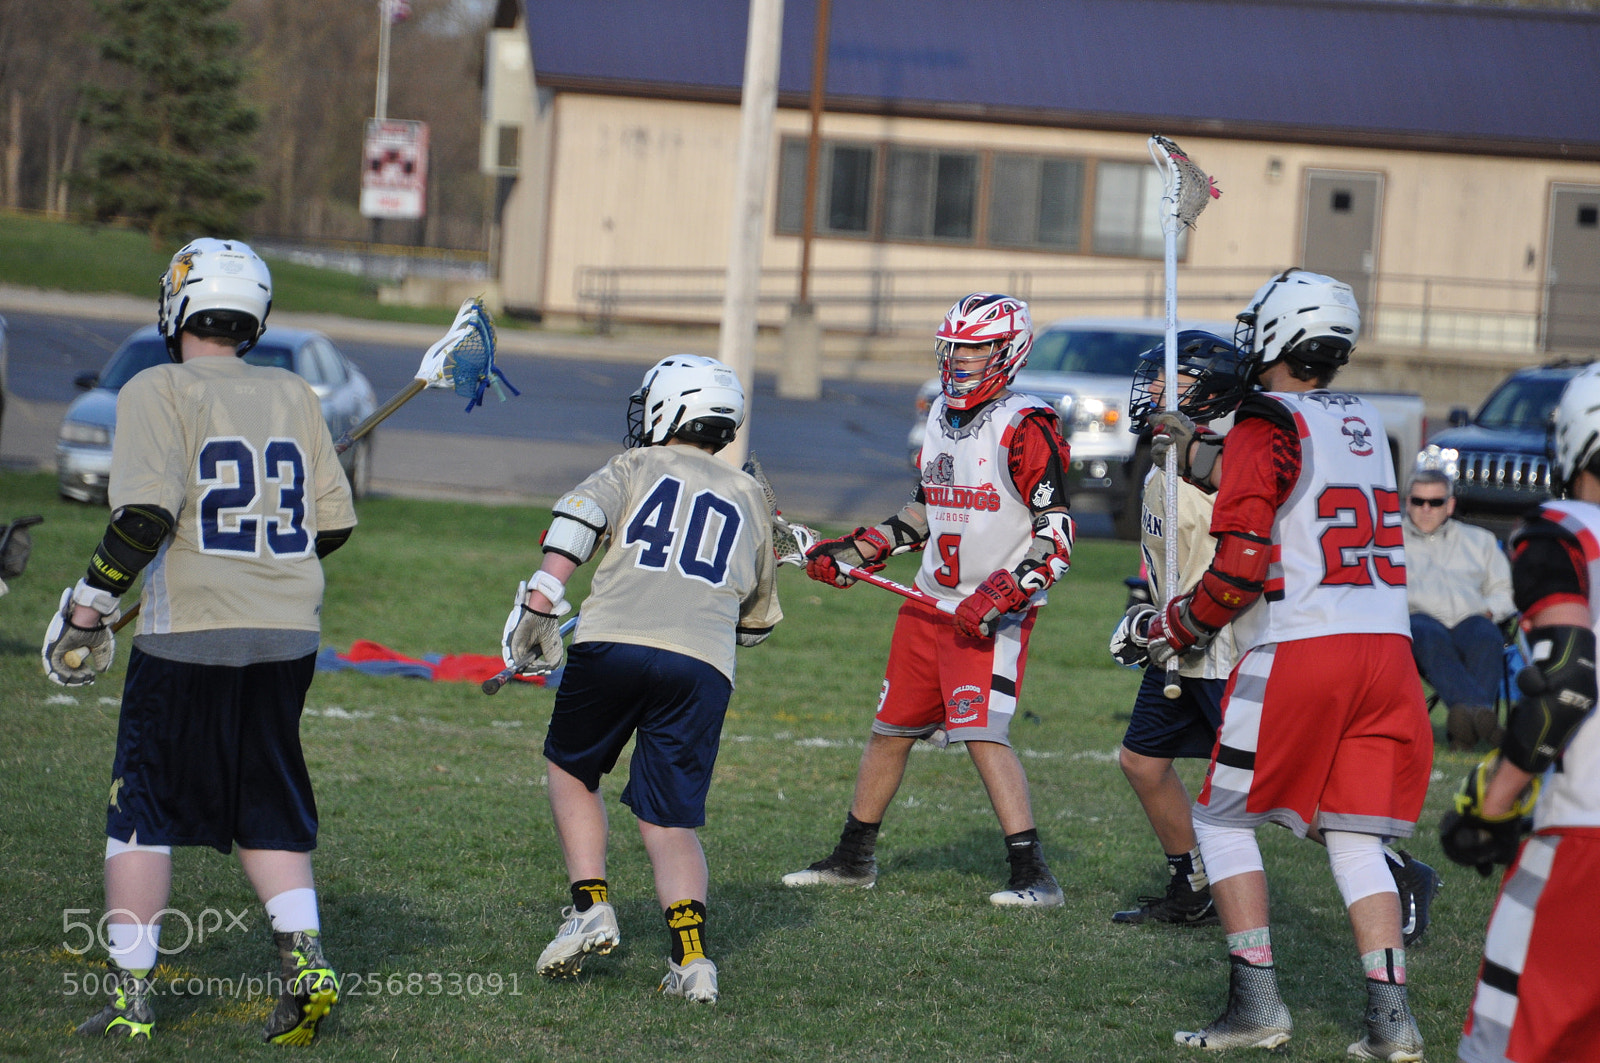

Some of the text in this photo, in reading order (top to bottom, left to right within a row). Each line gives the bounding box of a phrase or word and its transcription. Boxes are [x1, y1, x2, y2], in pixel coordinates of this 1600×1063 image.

[197, 436, 315, 559] 23
[621, 473, 744, 589] 40
[935, 510, 970, 524] LACROSE
[1314, 483, 1407, 589] 25
[933, 531, 962, 589] 9
